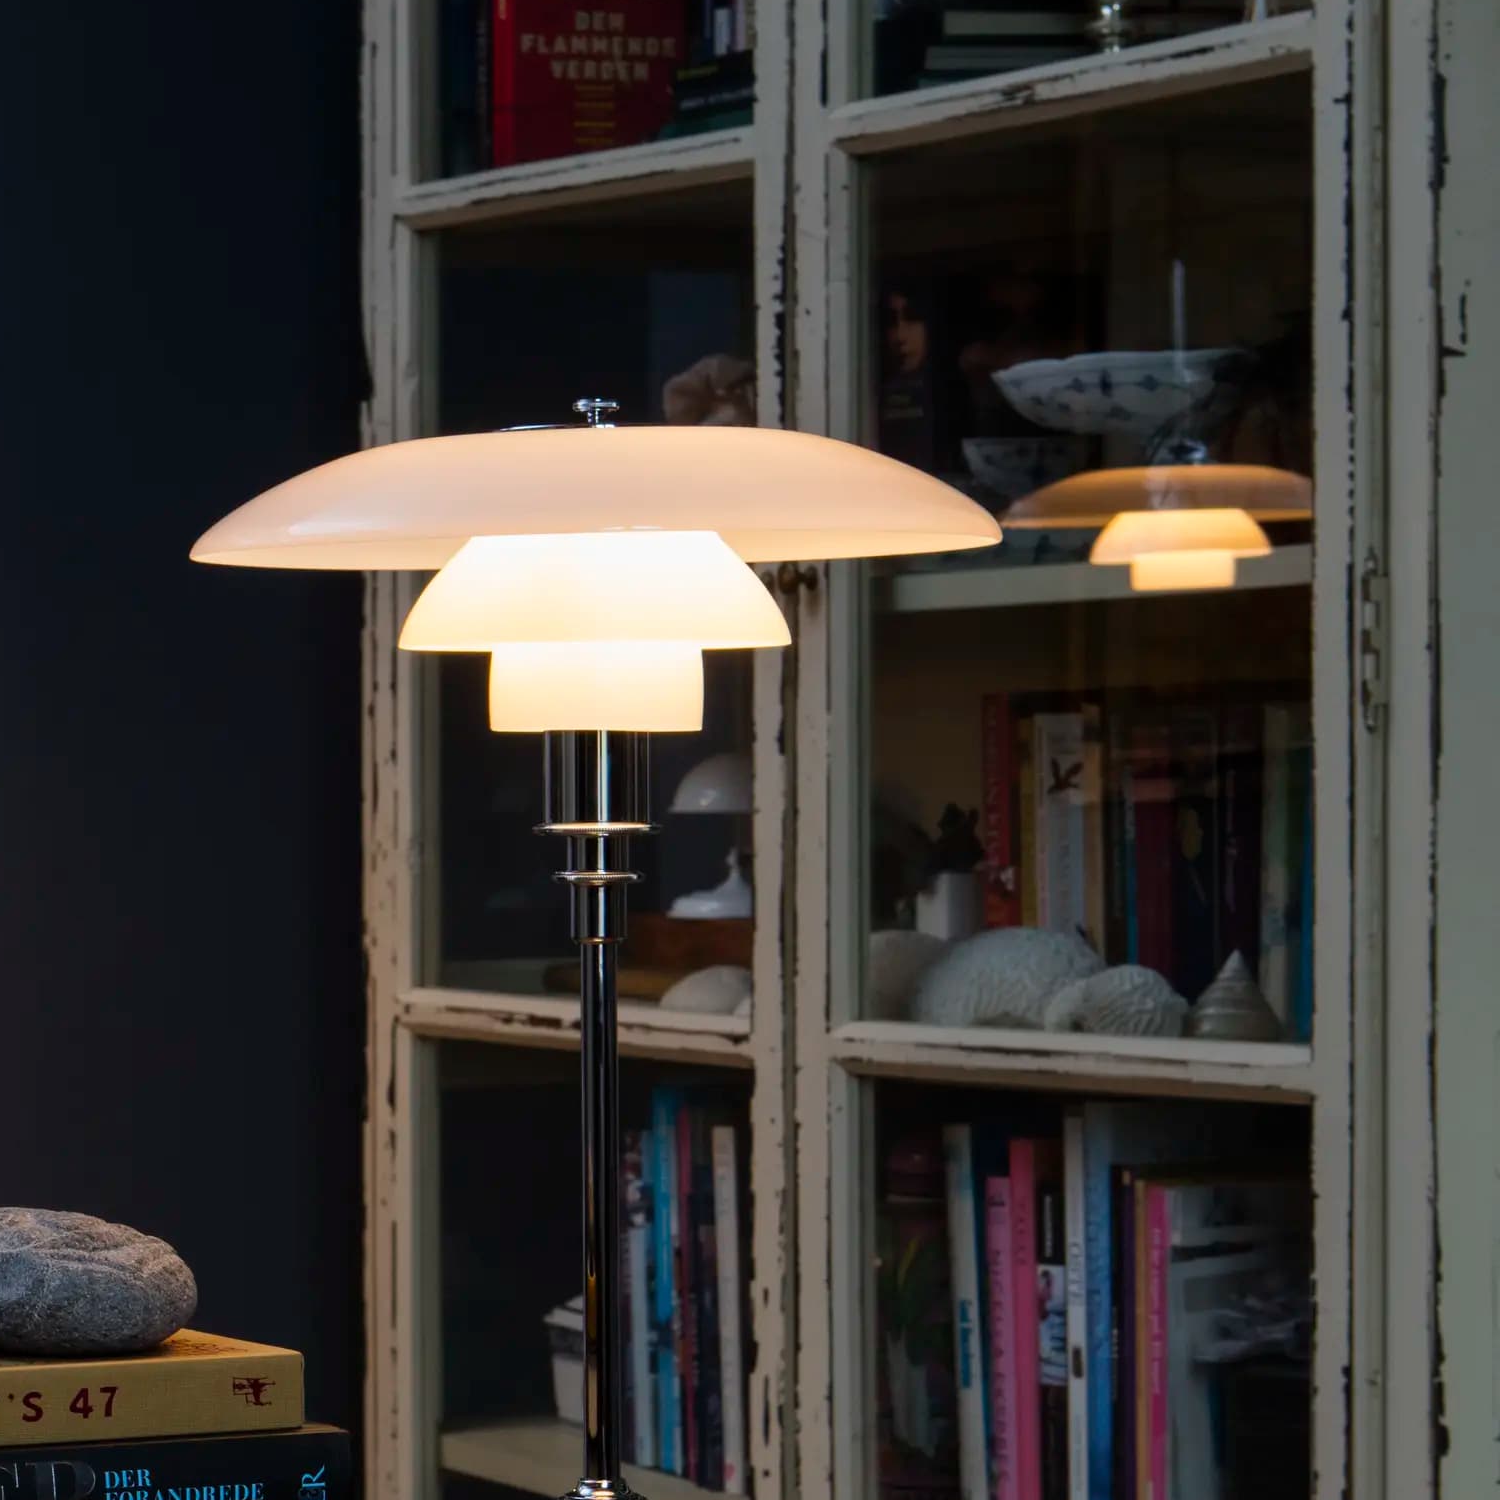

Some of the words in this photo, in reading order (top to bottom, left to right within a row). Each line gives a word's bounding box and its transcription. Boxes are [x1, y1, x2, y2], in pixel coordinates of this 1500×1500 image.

[519, 33, 676, 58] FLAMMENDE
[549, 60, 650, 81] VERDEN
[69, 1386, 119, 1419] 47
[104, 1468, 151, 1489] DER
